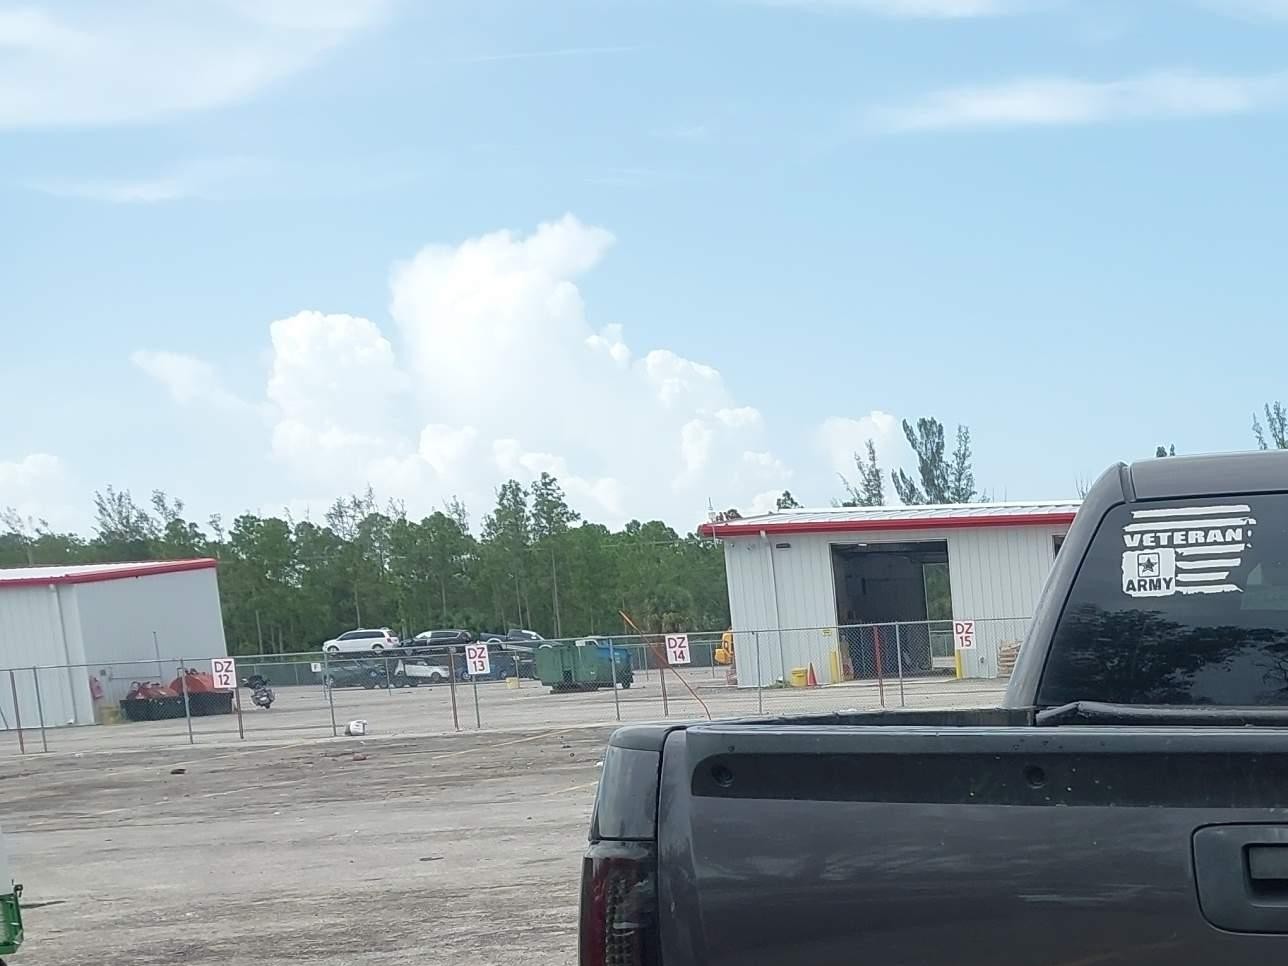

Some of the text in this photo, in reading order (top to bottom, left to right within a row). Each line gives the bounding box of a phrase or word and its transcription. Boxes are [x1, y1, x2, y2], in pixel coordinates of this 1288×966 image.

[1123, 528, 1243, 547] VETERAN
[1125, 577, 1174, 592] ARMY
[955, 623, 974, 635] DZ
[667, 637, 687, 649] DZ
[960, 636, 972, 648] 15
[467, 647, 487, 660] DZ
[673, 650, 686, 662] 14
[214, 661, 233, 673] DZ
[472, 660, 486, 673] 13
[218, 674, 230, 686] 12
